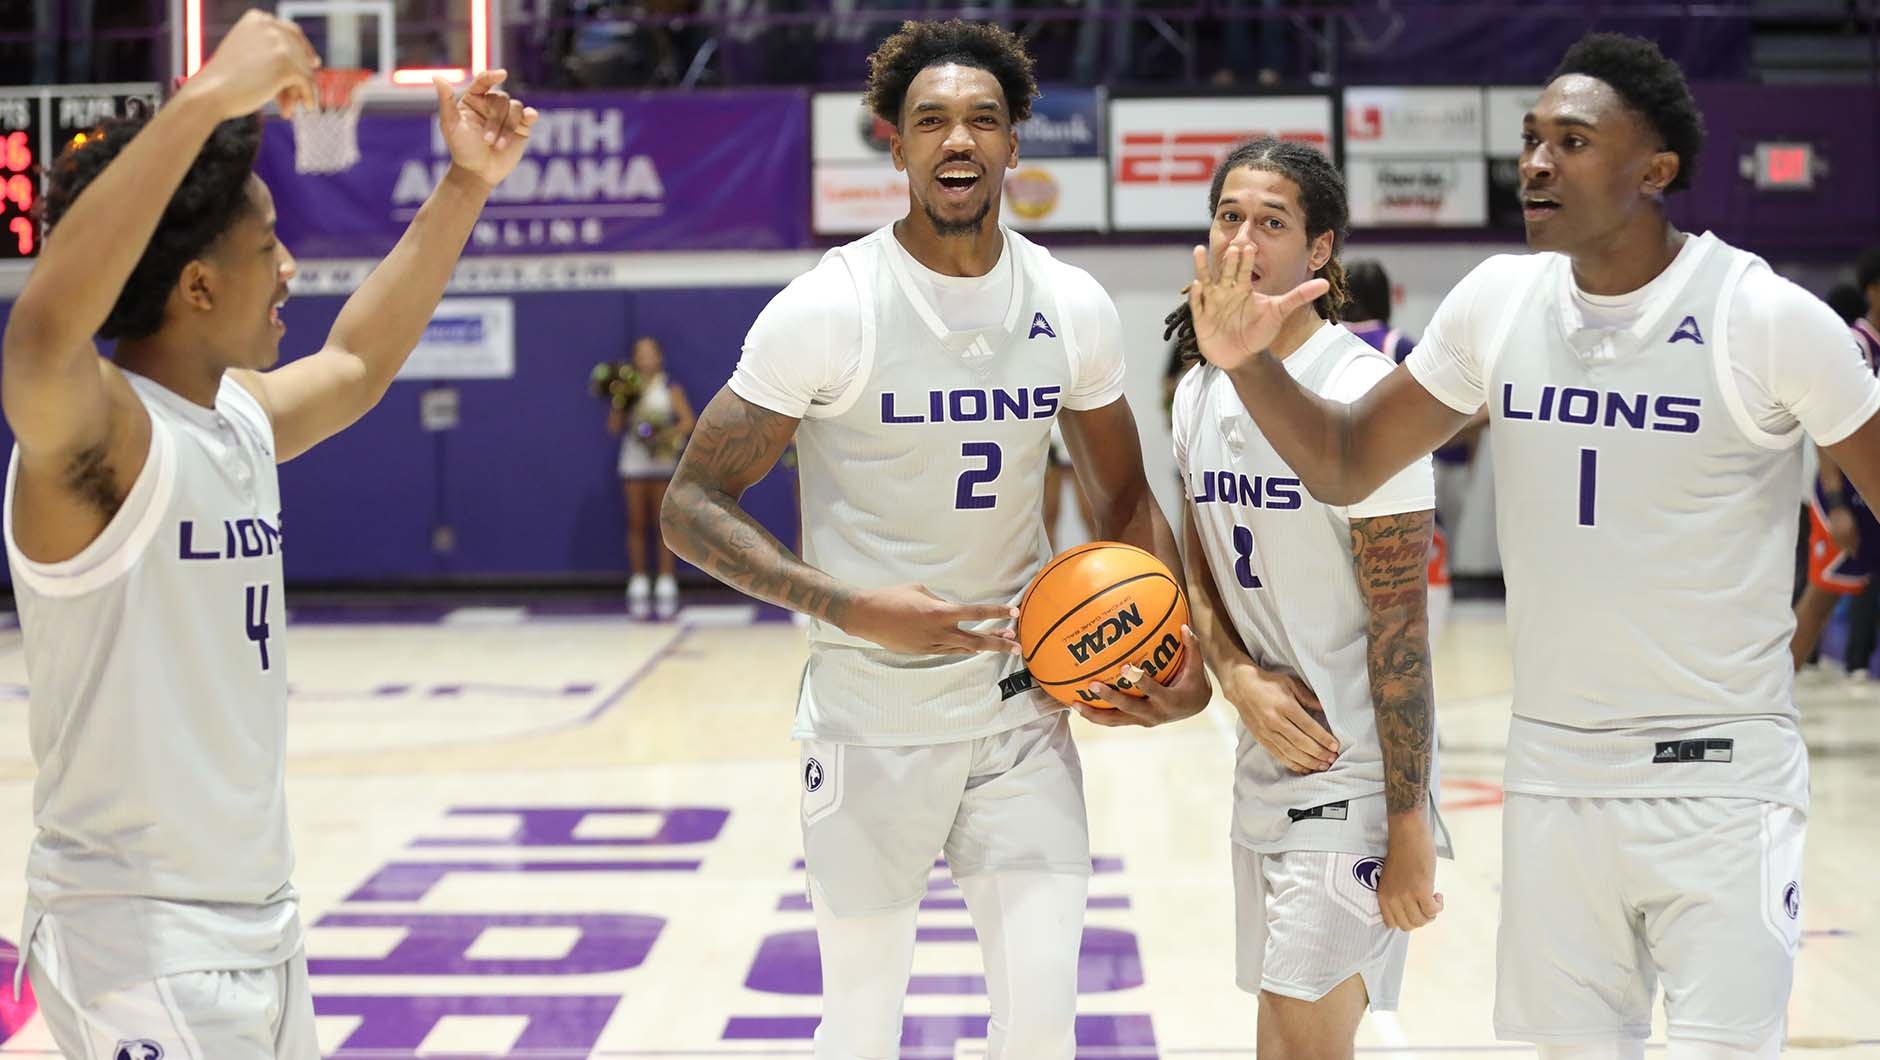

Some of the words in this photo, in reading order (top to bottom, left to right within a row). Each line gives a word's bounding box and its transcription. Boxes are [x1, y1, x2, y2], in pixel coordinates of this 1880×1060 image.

[880, 385, 1062, 424] LIONS
[1502, 382, 1702, 434] LIONS
[955, 441, 1003, 510] 2
[1578, 448, 1597, 526] 1
[179, 512, 283, 560] LION
[246, 584, 270, 671] 4
[1067, 602, 1143, 664] NCAA
